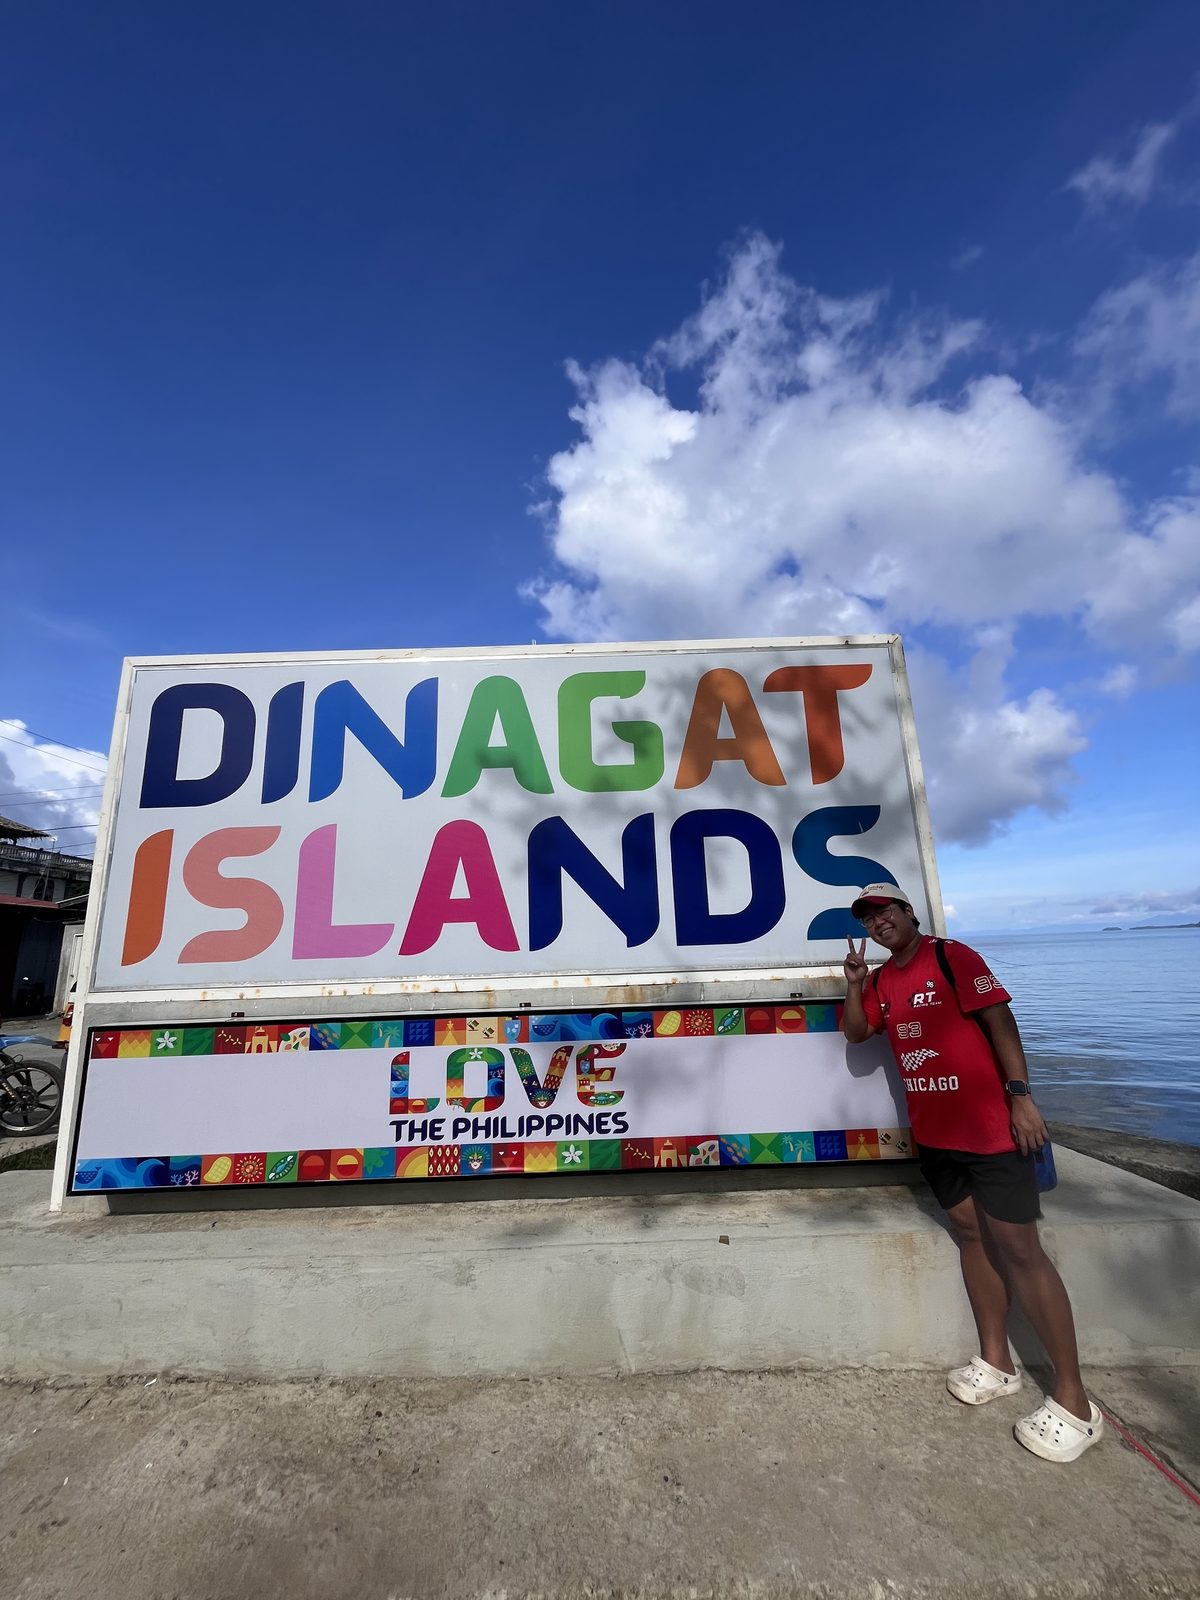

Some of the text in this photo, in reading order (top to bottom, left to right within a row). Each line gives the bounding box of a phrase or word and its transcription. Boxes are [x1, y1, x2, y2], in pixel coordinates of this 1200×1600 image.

[139, 664, 873, 808] DINAGAT
[121, 805, 900, 967] ISLANDS
[913, 992, 936, 1005] RT
[896, 1021, 922, 1040] 93
[389, 1043, 627, 1114] LOVE
[389, 1112, 629, 1142] THE PHILIPPINES
